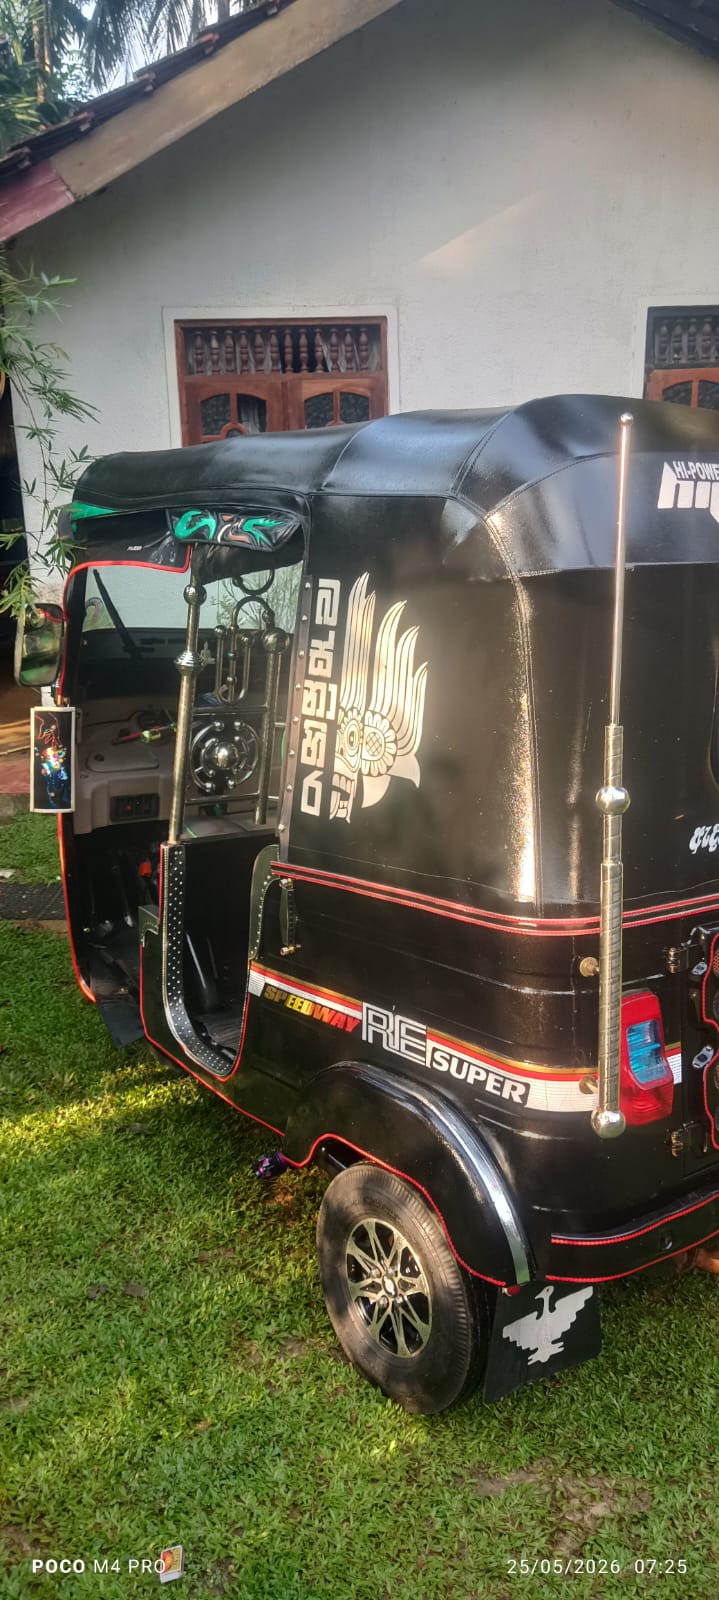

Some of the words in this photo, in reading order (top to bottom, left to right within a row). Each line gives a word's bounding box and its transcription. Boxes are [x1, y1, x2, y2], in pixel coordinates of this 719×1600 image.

[263, 985, 361, 1033] SPEEDWAY
[362, 1001, 427, 1066] RE
[433, 1050, 527, 1104] SUPER
